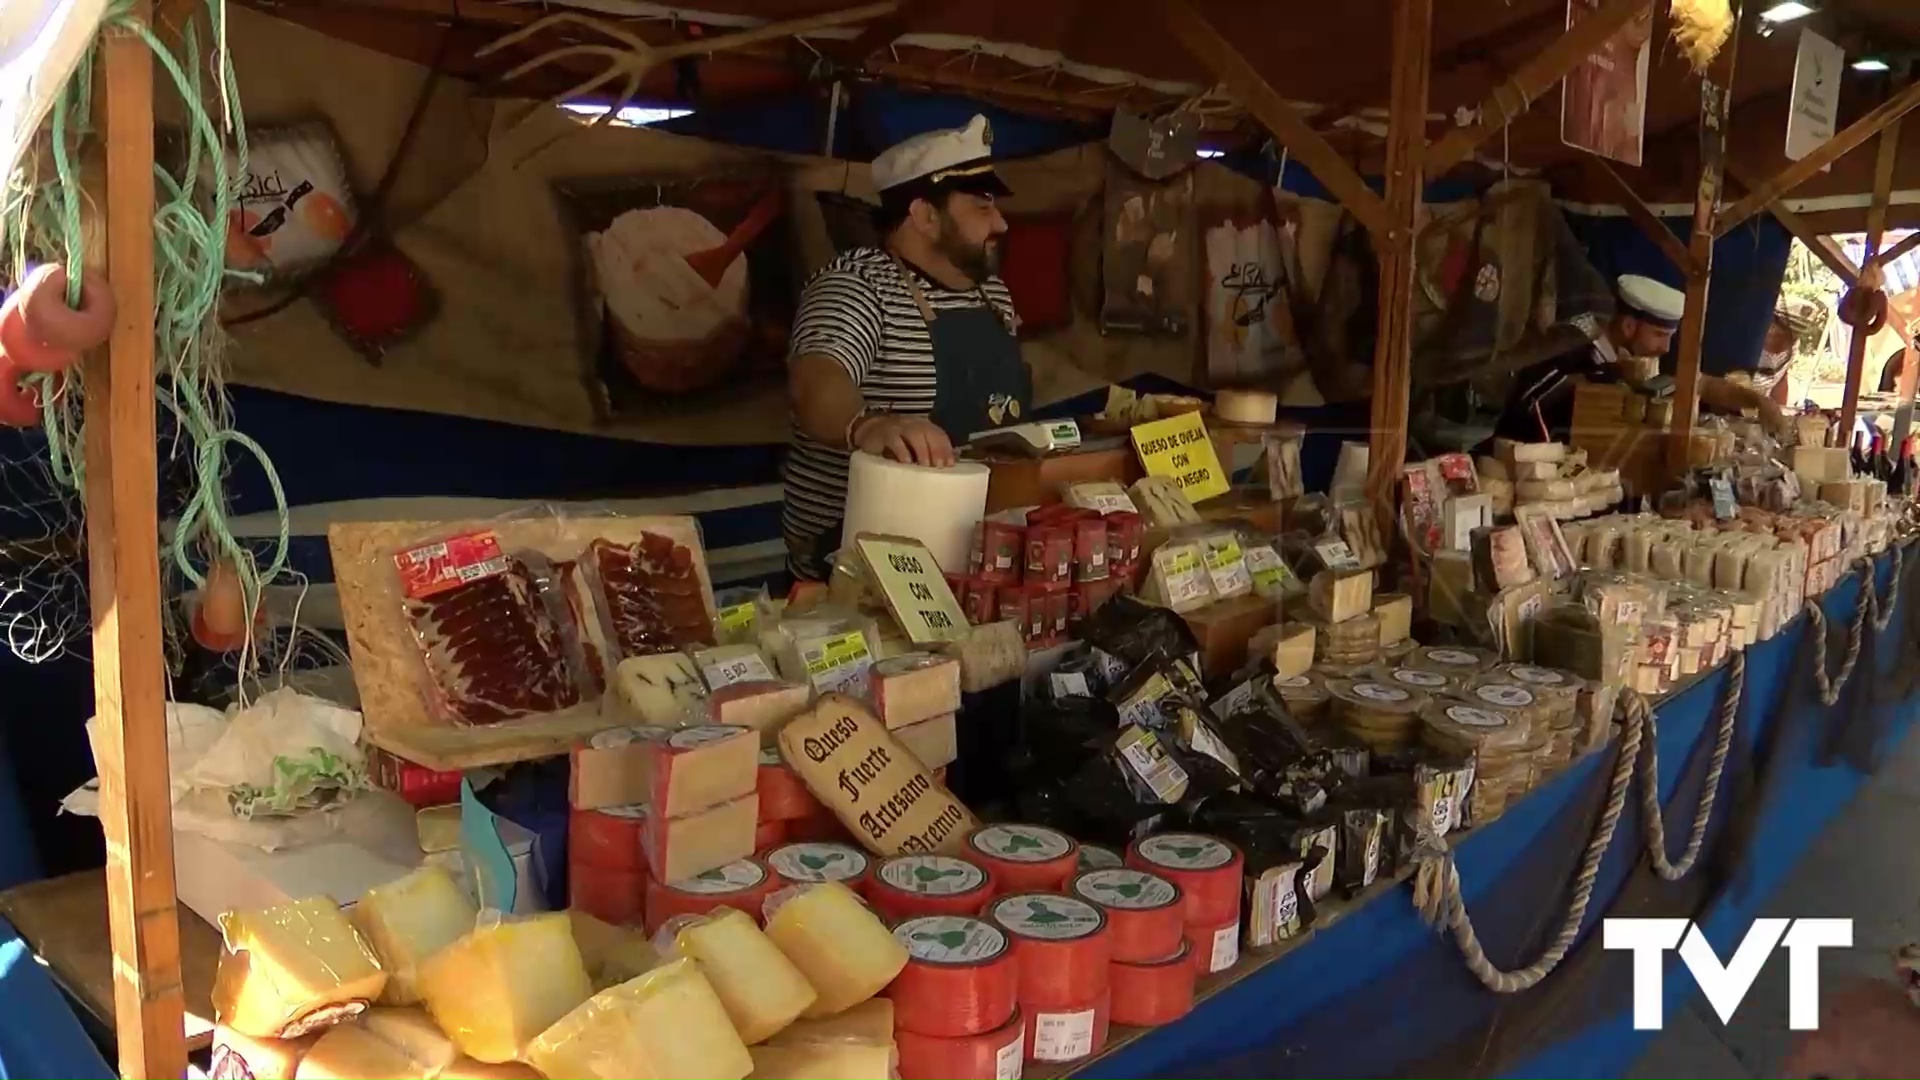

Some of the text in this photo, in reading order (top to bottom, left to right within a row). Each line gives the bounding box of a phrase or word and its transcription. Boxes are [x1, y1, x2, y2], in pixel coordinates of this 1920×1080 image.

[1140, 427, 1205, 456] QUESO DE OVEJA
[1171, 453, 1190, 469] CON
[1182, 468, 1210, 487] NEGRO
[888, 553, 924, 574] QUESO
[909, 582, 934, 601] CON
[918, 610, 954, 629] TRUFA
[803, 716, 859, 763] Queso
[838, 746, 892, 804] Fuerte
[859, 773, 930, 841] Artesano
